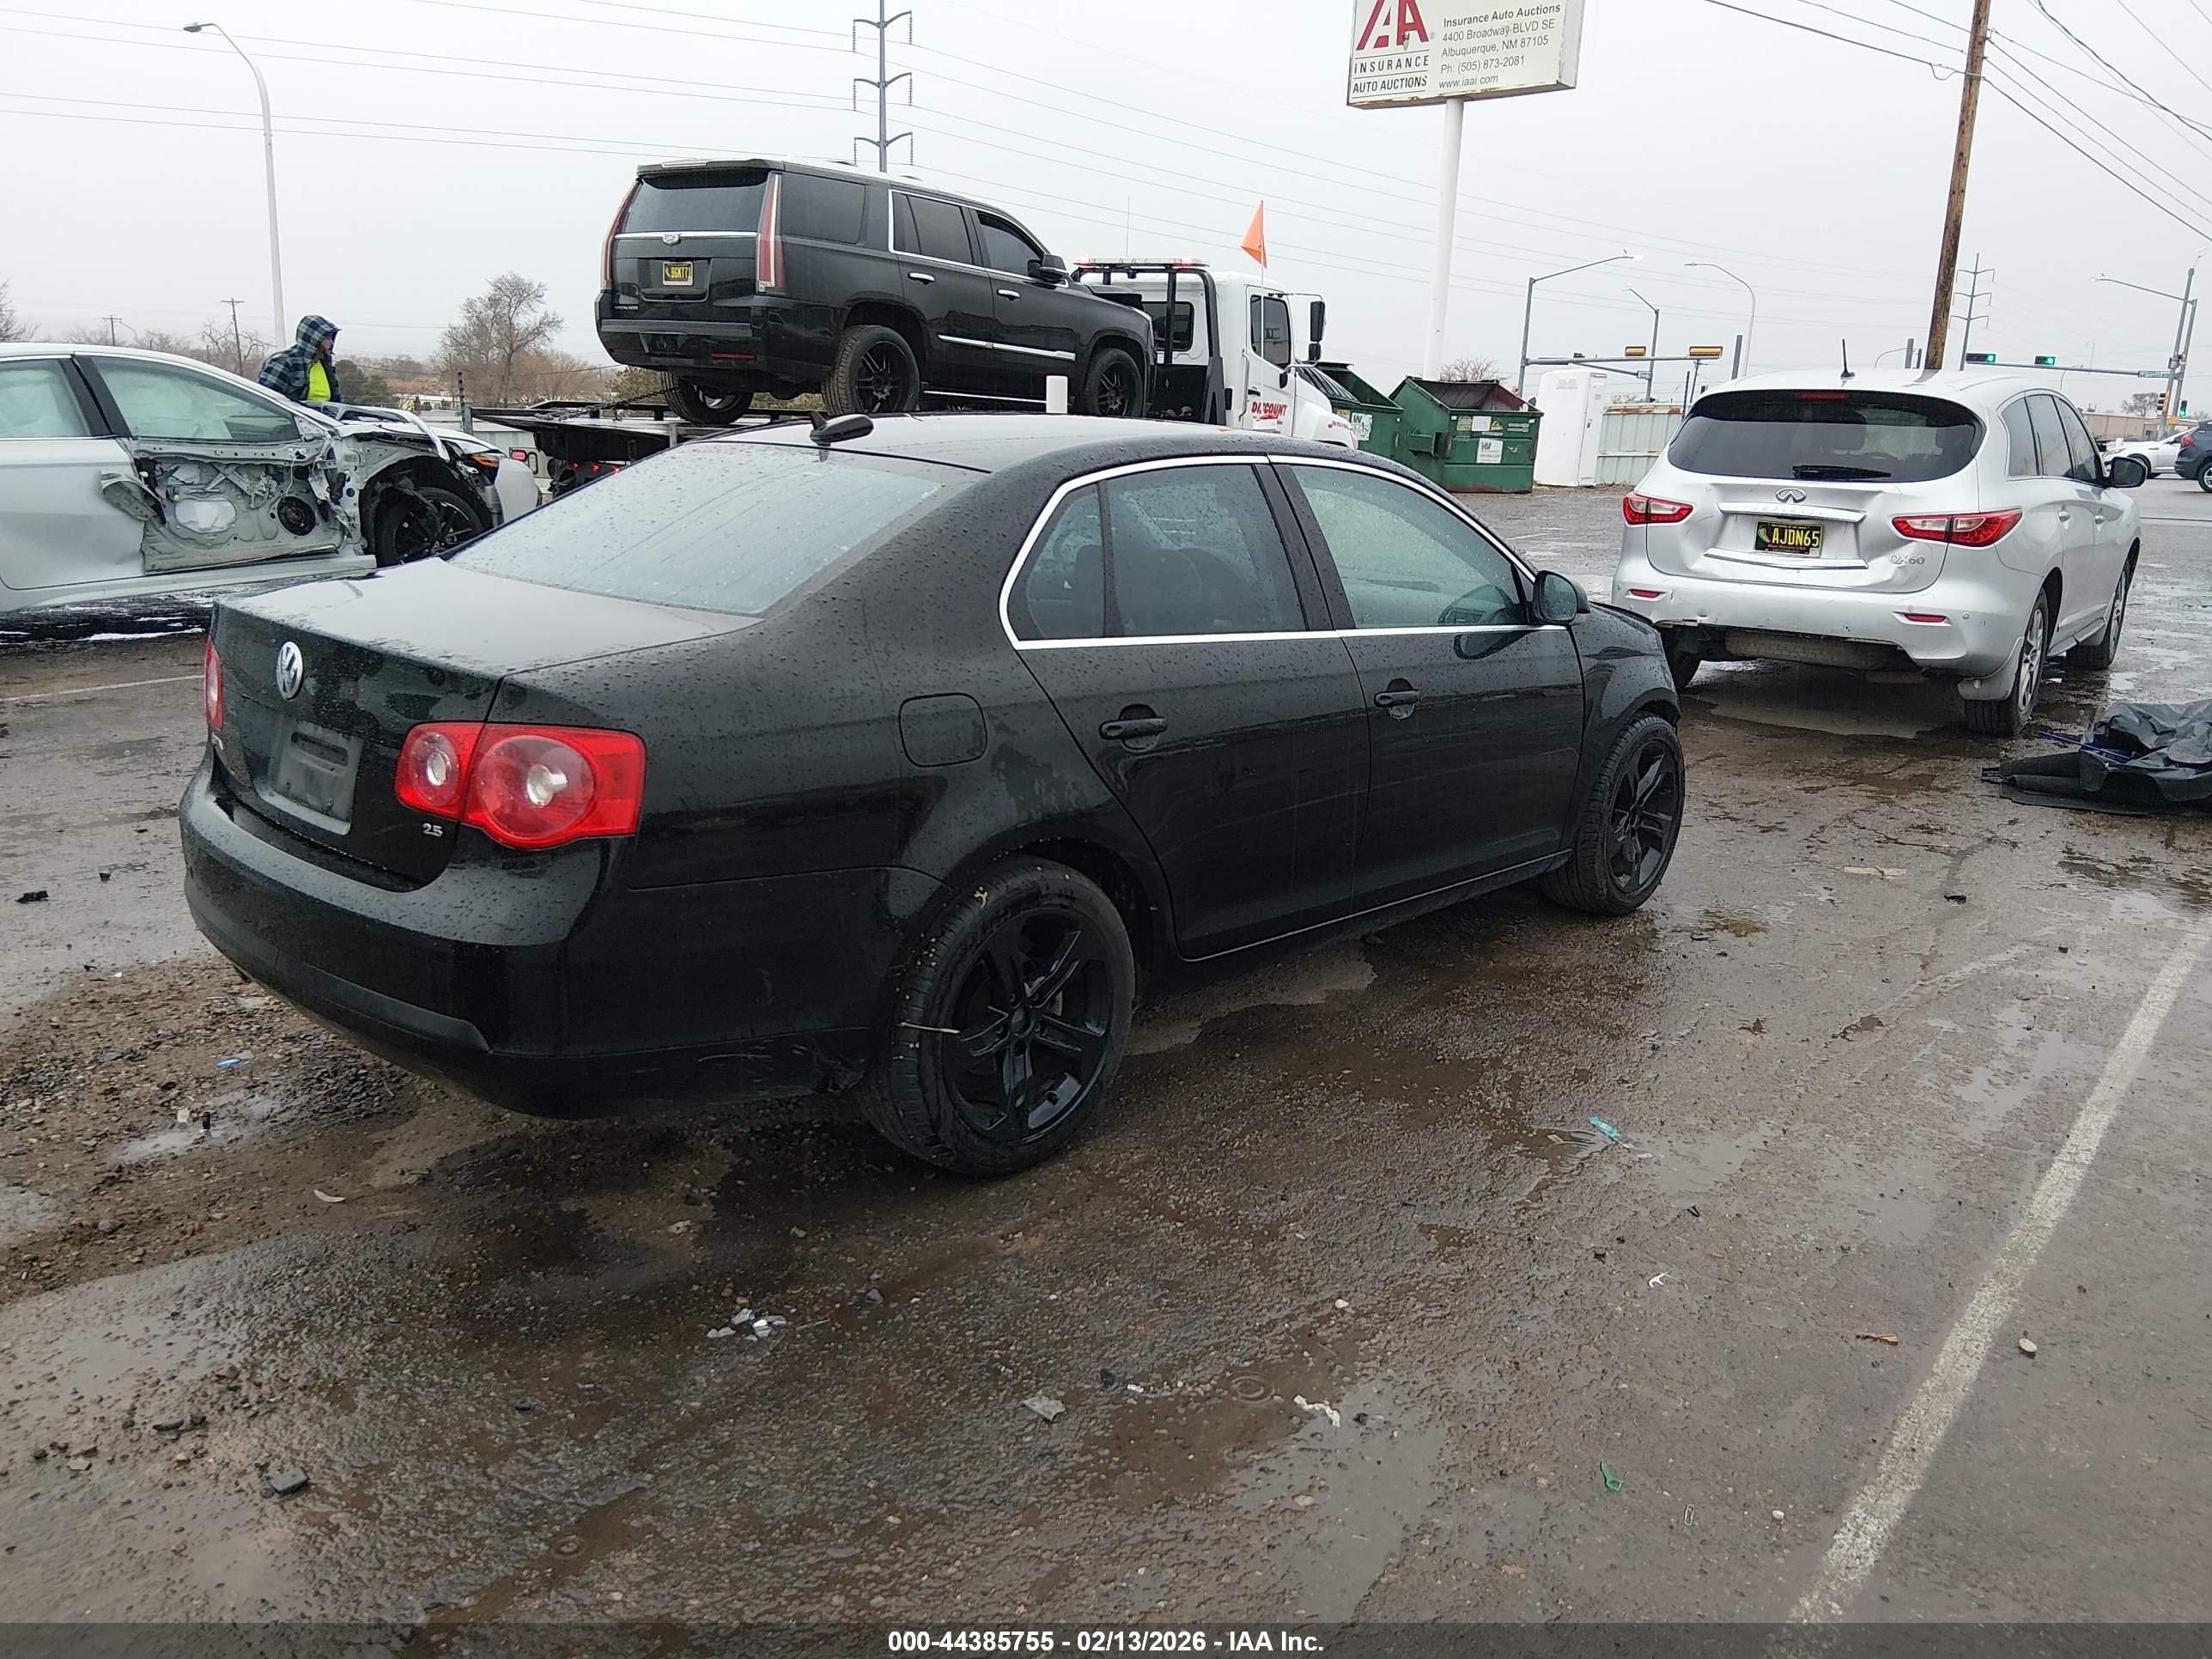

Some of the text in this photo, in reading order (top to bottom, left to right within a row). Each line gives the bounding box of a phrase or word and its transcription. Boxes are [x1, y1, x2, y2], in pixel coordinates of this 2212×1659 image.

[1443, 4, 1561, 27] Insurance Auto Auctions
[1443, 18, 1556, 43] 4400 Broadway BLVD SE
[1442, 34, 1549, 58] Albuquerque, NM 87105
[1354, 55, 1429, 74] INSURANCE
[1458, 60, 1481, 74] (505)
[1483, 55, 1525, 70] 873-2081
[1352, 75, 1428, 94] AUTO AUCTIONS
[1439, 75, 1498, 88] www.iaai.com
[1772, 527, 1820, 547] AJDN65
[1890, 555, 1924, 564] QX60
